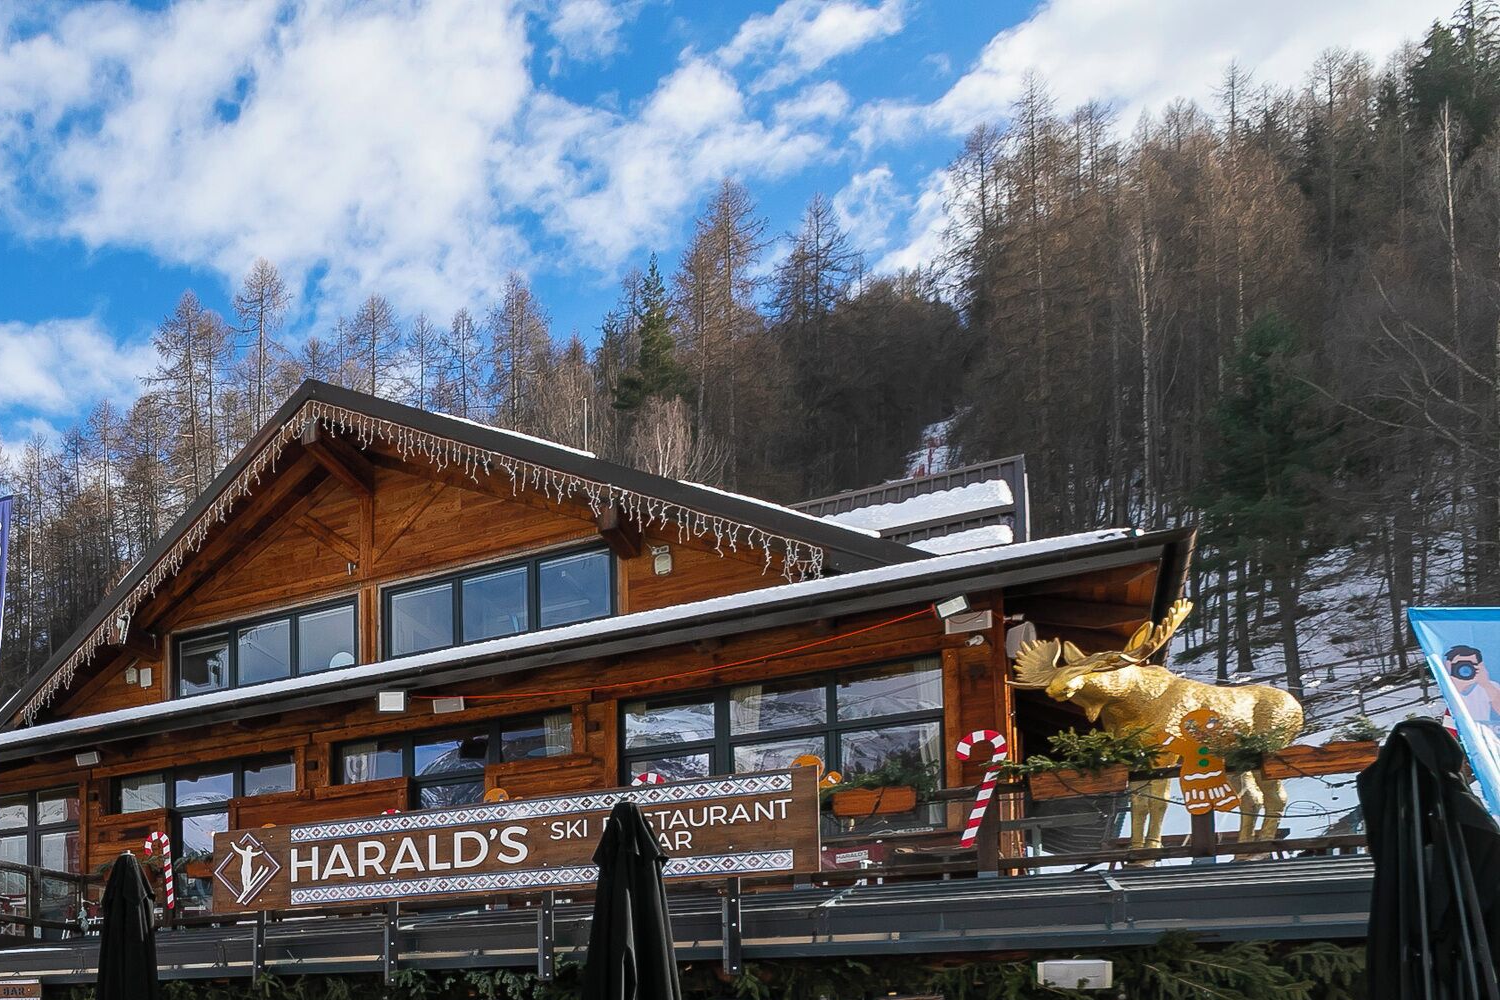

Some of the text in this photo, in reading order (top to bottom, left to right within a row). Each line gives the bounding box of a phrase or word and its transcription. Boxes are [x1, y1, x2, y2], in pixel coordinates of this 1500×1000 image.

[549, 798, 793, 841] SKI STAURANT
[658, 829, 693, 853] AR
[289, 825, 529, 884] HARALD'S
